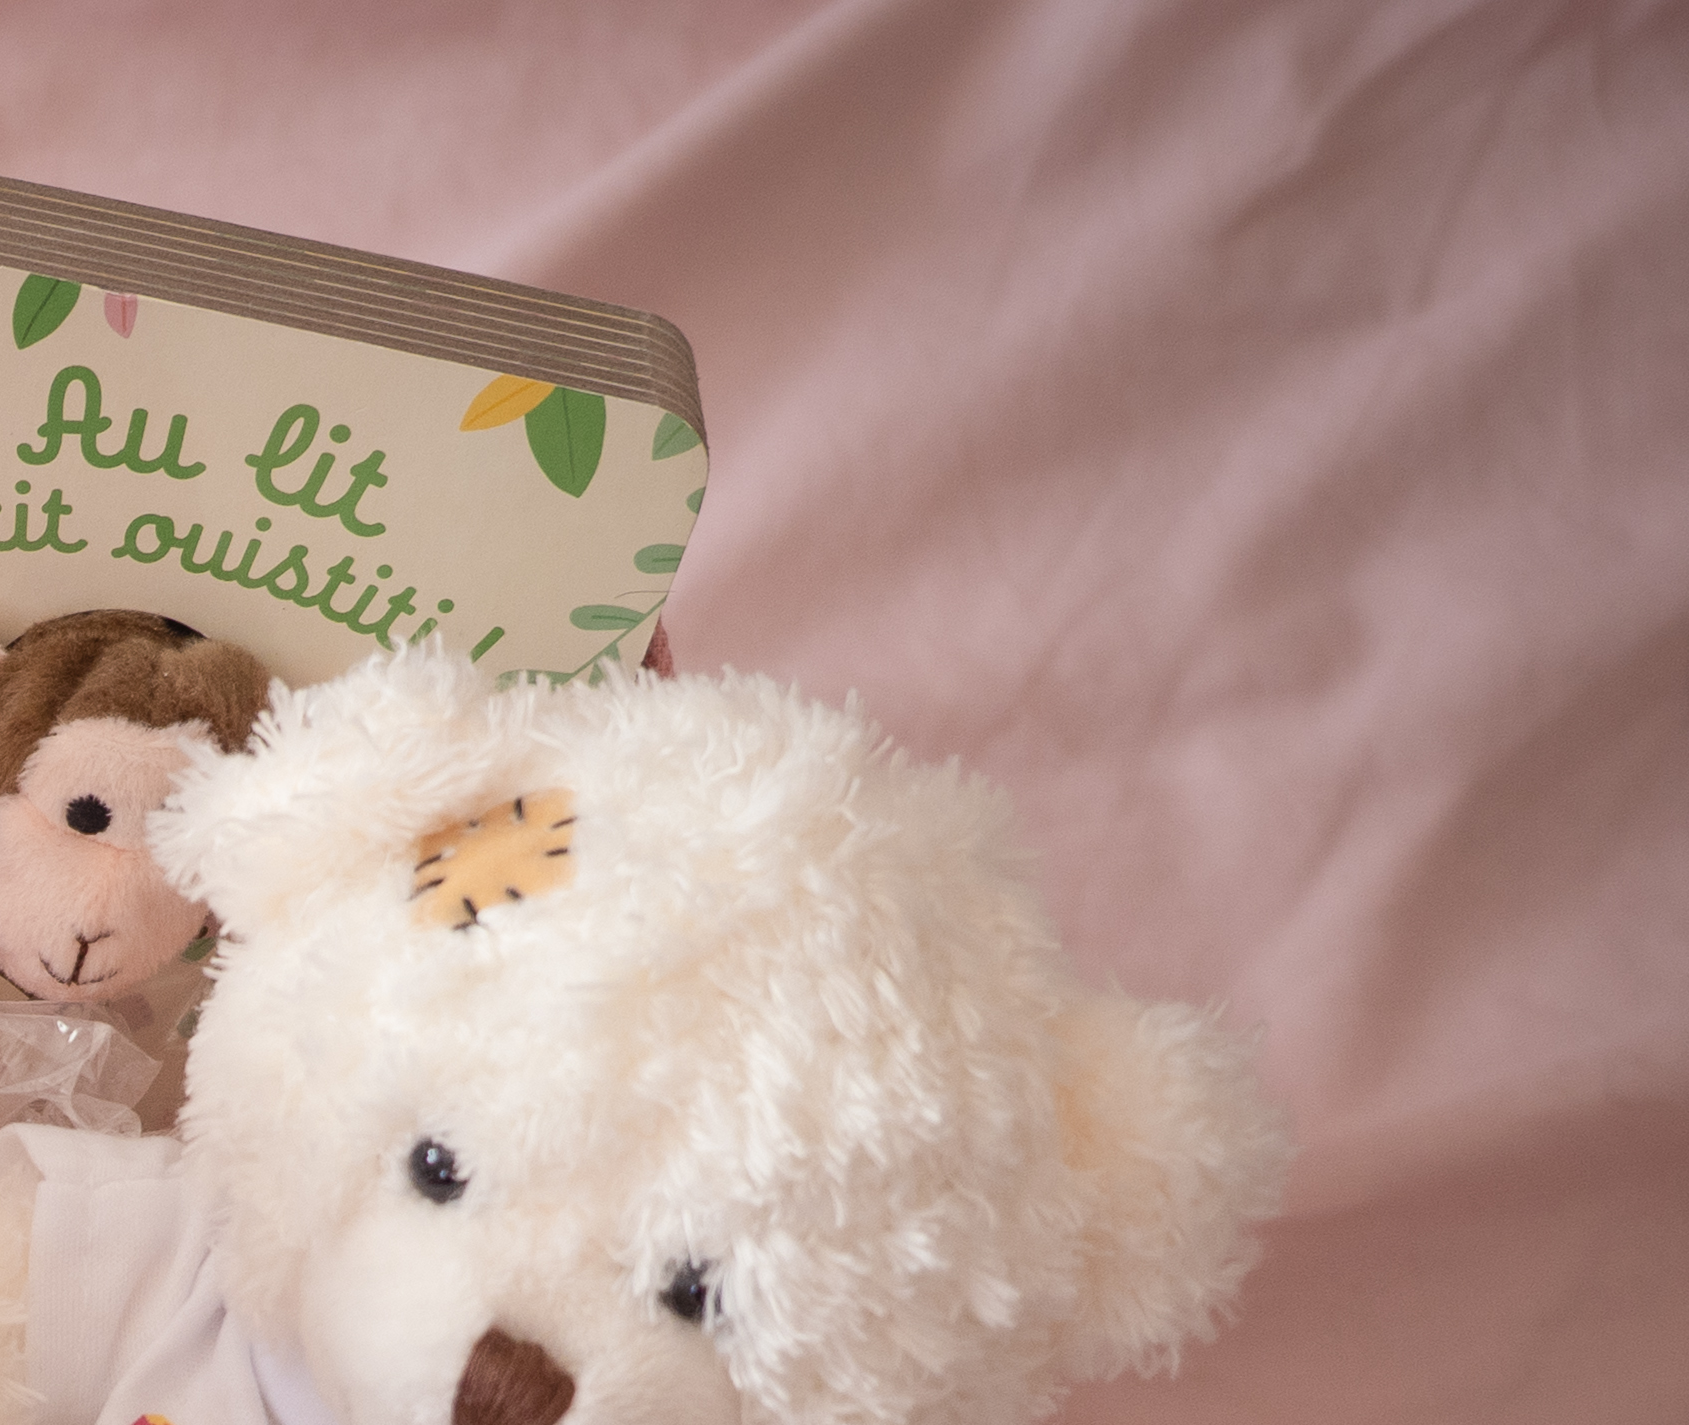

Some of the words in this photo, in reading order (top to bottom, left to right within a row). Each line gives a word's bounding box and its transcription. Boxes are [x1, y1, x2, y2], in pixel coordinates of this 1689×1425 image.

[15, 365, 206, 482] Au
[246, 402, 390, 539] lit
[111, 513, 455, 652] ouistiti
